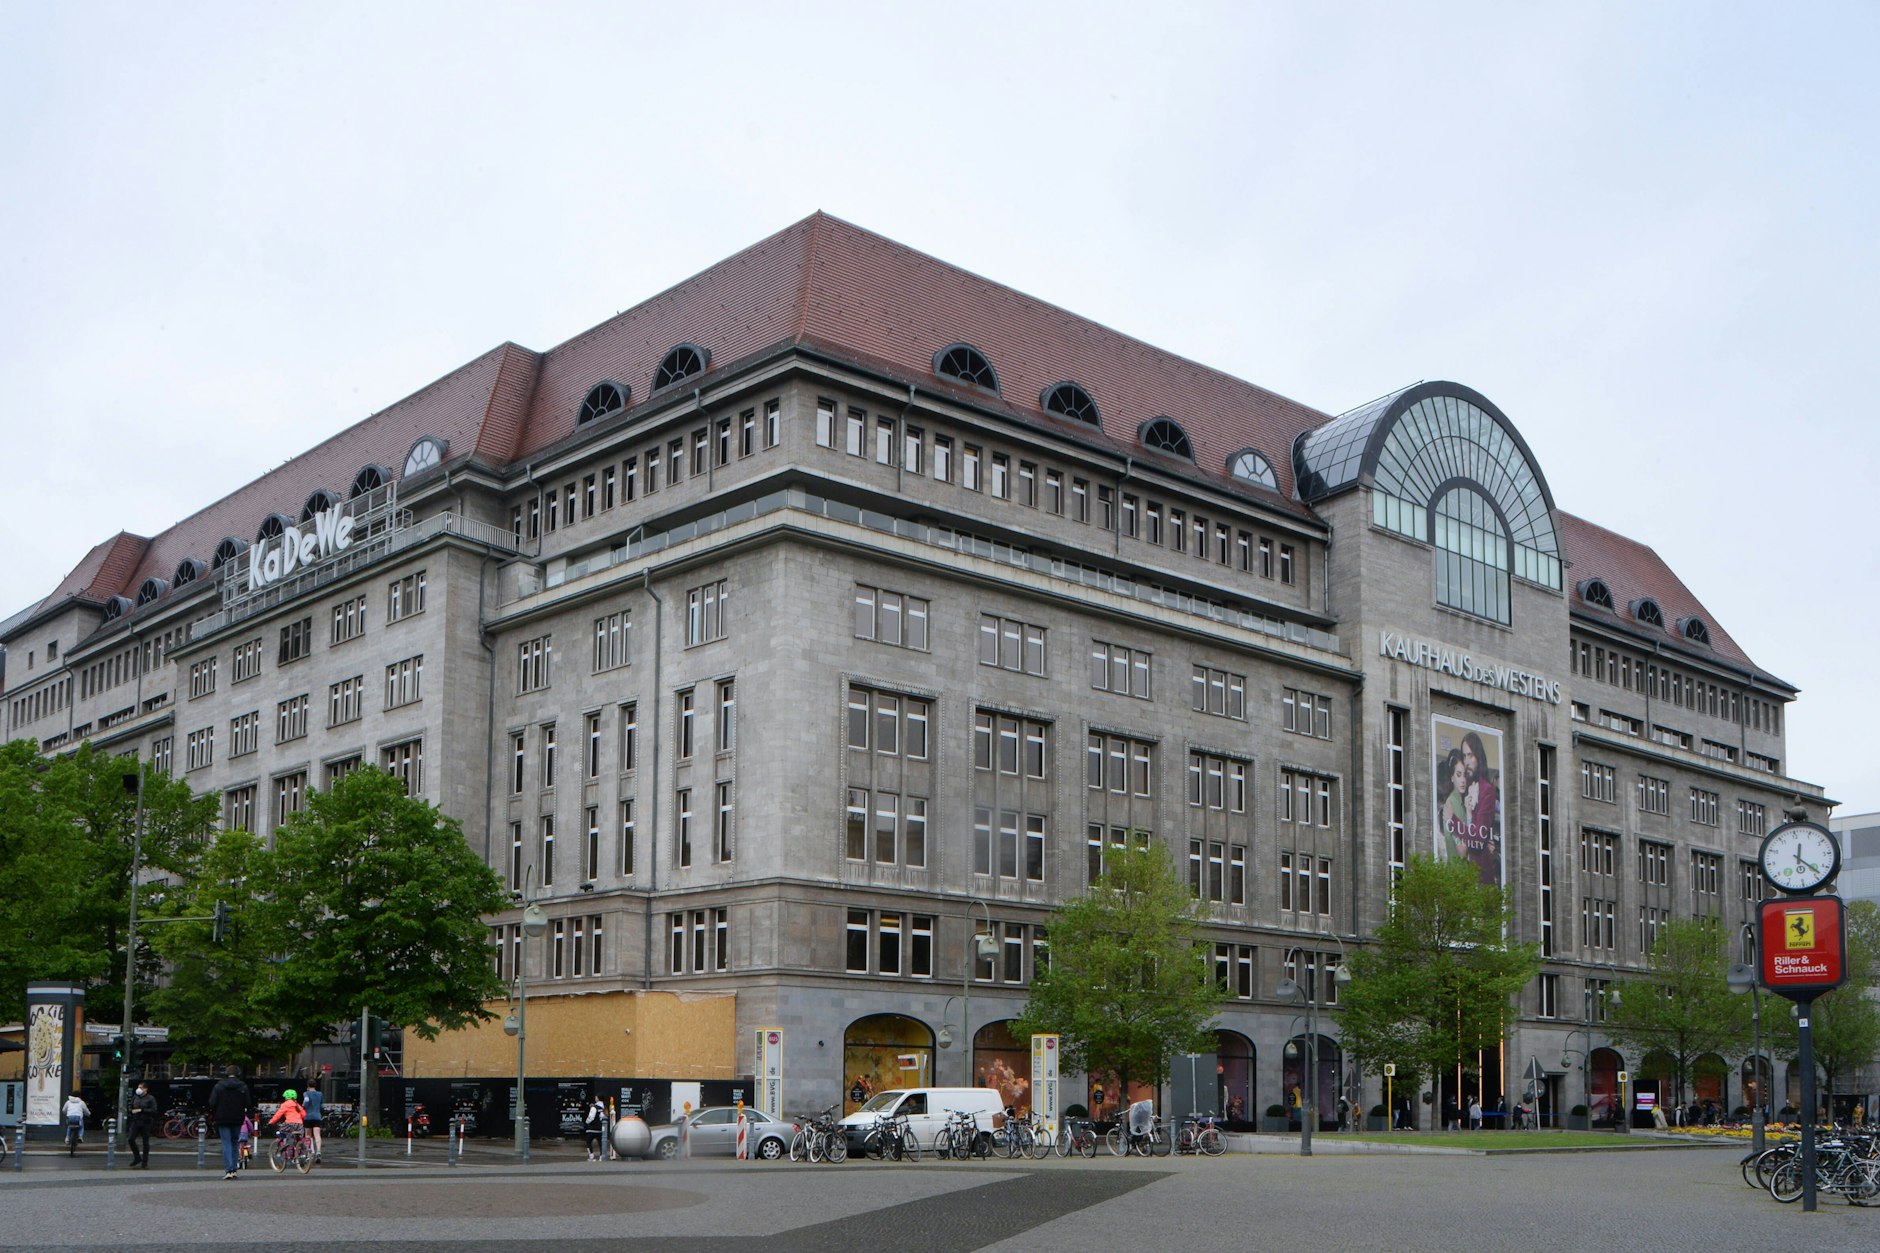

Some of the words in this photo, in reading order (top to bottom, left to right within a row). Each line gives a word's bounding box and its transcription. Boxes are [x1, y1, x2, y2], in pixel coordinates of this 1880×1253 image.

[249, 502, 355, 591] KaDeWe
[1380, 631, 1473, 681] KAUFHAUS
[1494, 664, 1562, 705] WESTENS
[1446, 818, 1493, 840] GUCCI
[1775, 963, 1828, 974] Schnauck
